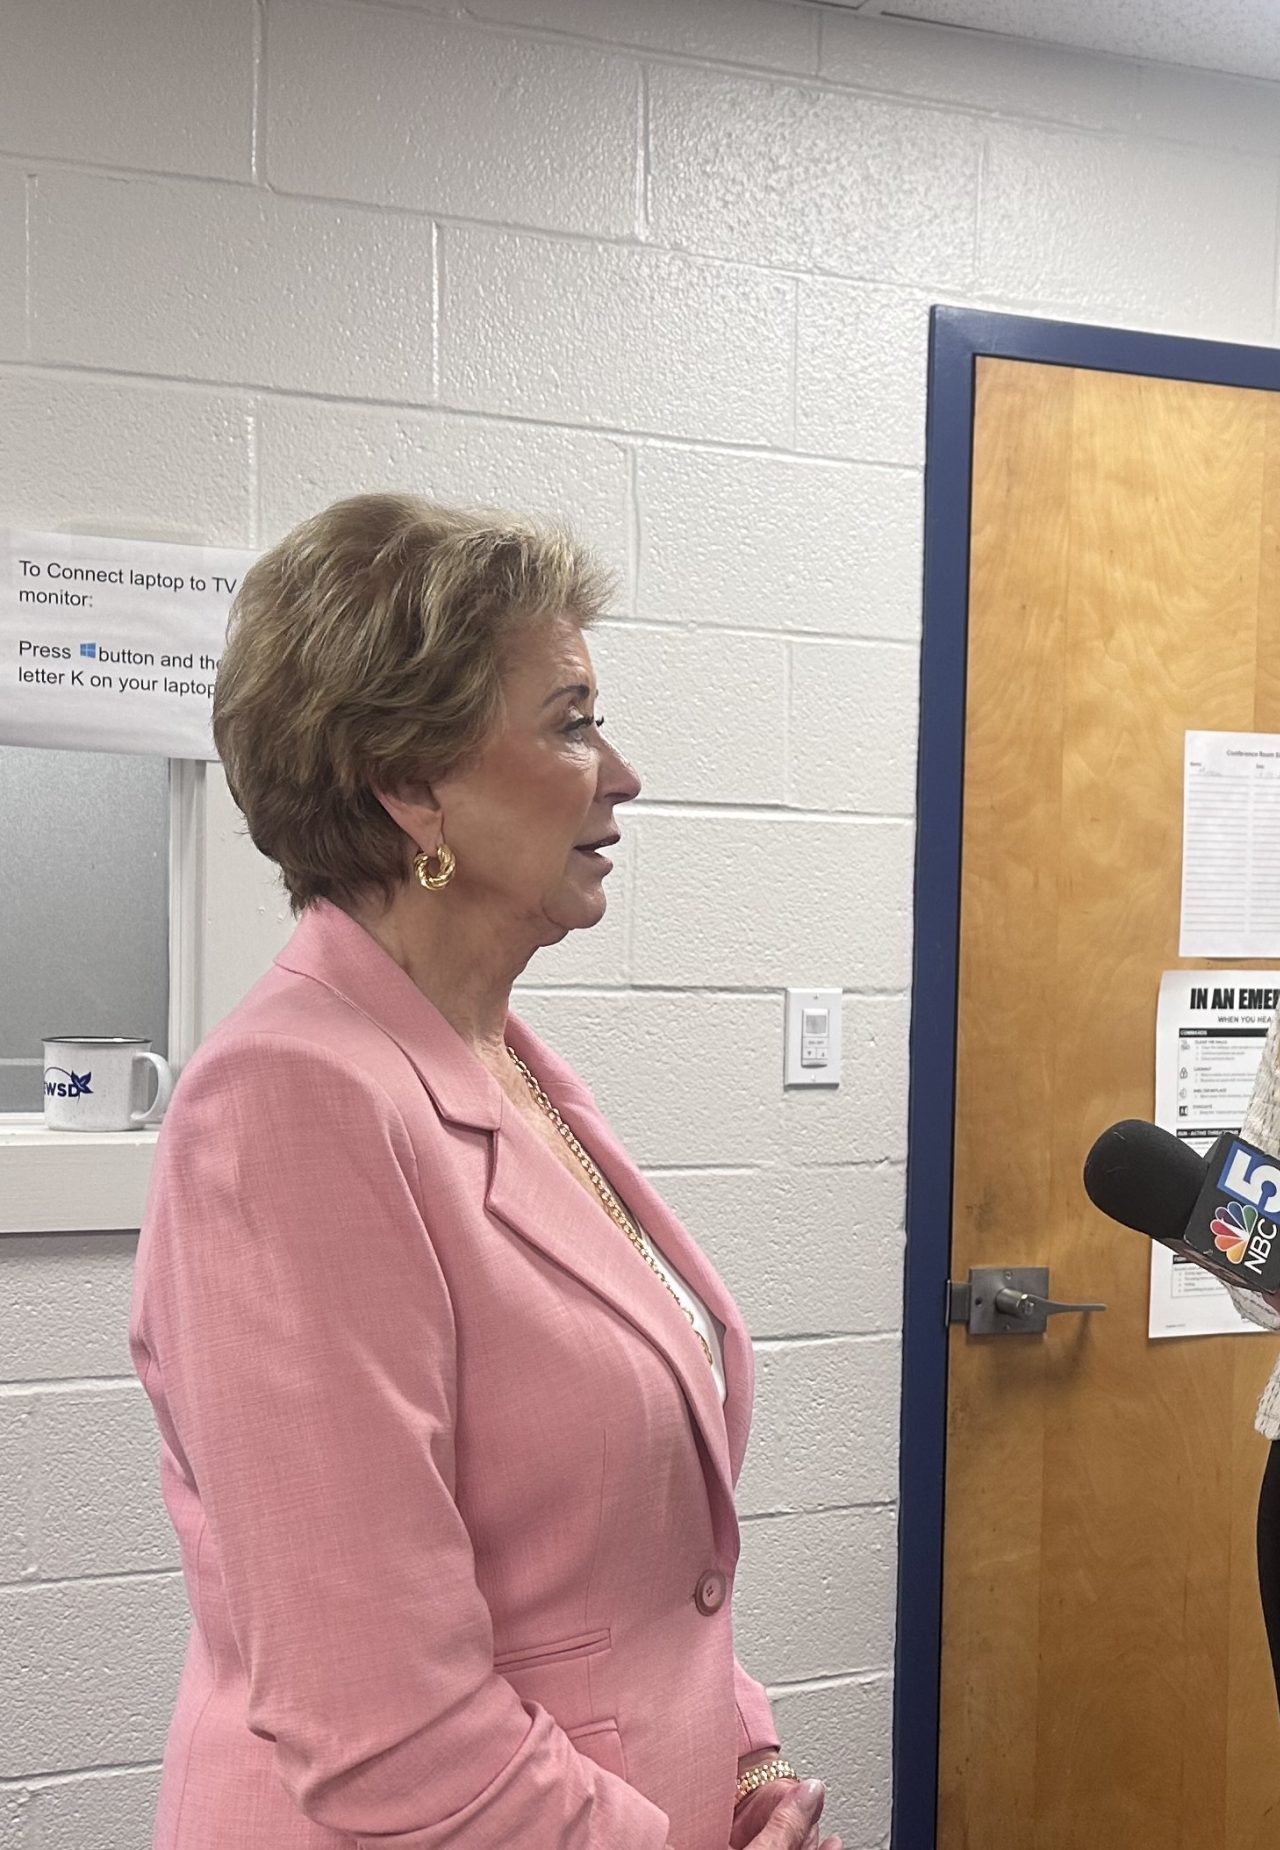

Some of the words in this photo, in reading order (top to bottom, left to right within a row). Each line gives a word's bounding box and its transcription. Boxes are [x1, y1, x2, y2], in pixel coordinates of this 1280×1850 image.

[18, 559, 41, 578] To
[47, 562, 124, 584] Connect
[130, 569, 184, 592] laptop
[190, 576, 206, 591] to
[212, 577, 237, 594] TV
[19, 589, 93, 608] monitor:
[19, 640, 72, 660] Press
[98, 646, 154, 666] button
[160, 653, 193, 669] and
[18, 666, 65, 685] letter
[71, 670, 85, 687] K
[90, 675, 112, 689] on
[119, 677, 158, 693] your
[1190, 988, 1208, 1010] IN
[1211, 988, 1235, 1010] AN
[1218, 1015, 1239, 1023] WHEN
[1241, 1015, 1256, 1023] YOU
[1243, 1217, 1278, 1276] NBC
